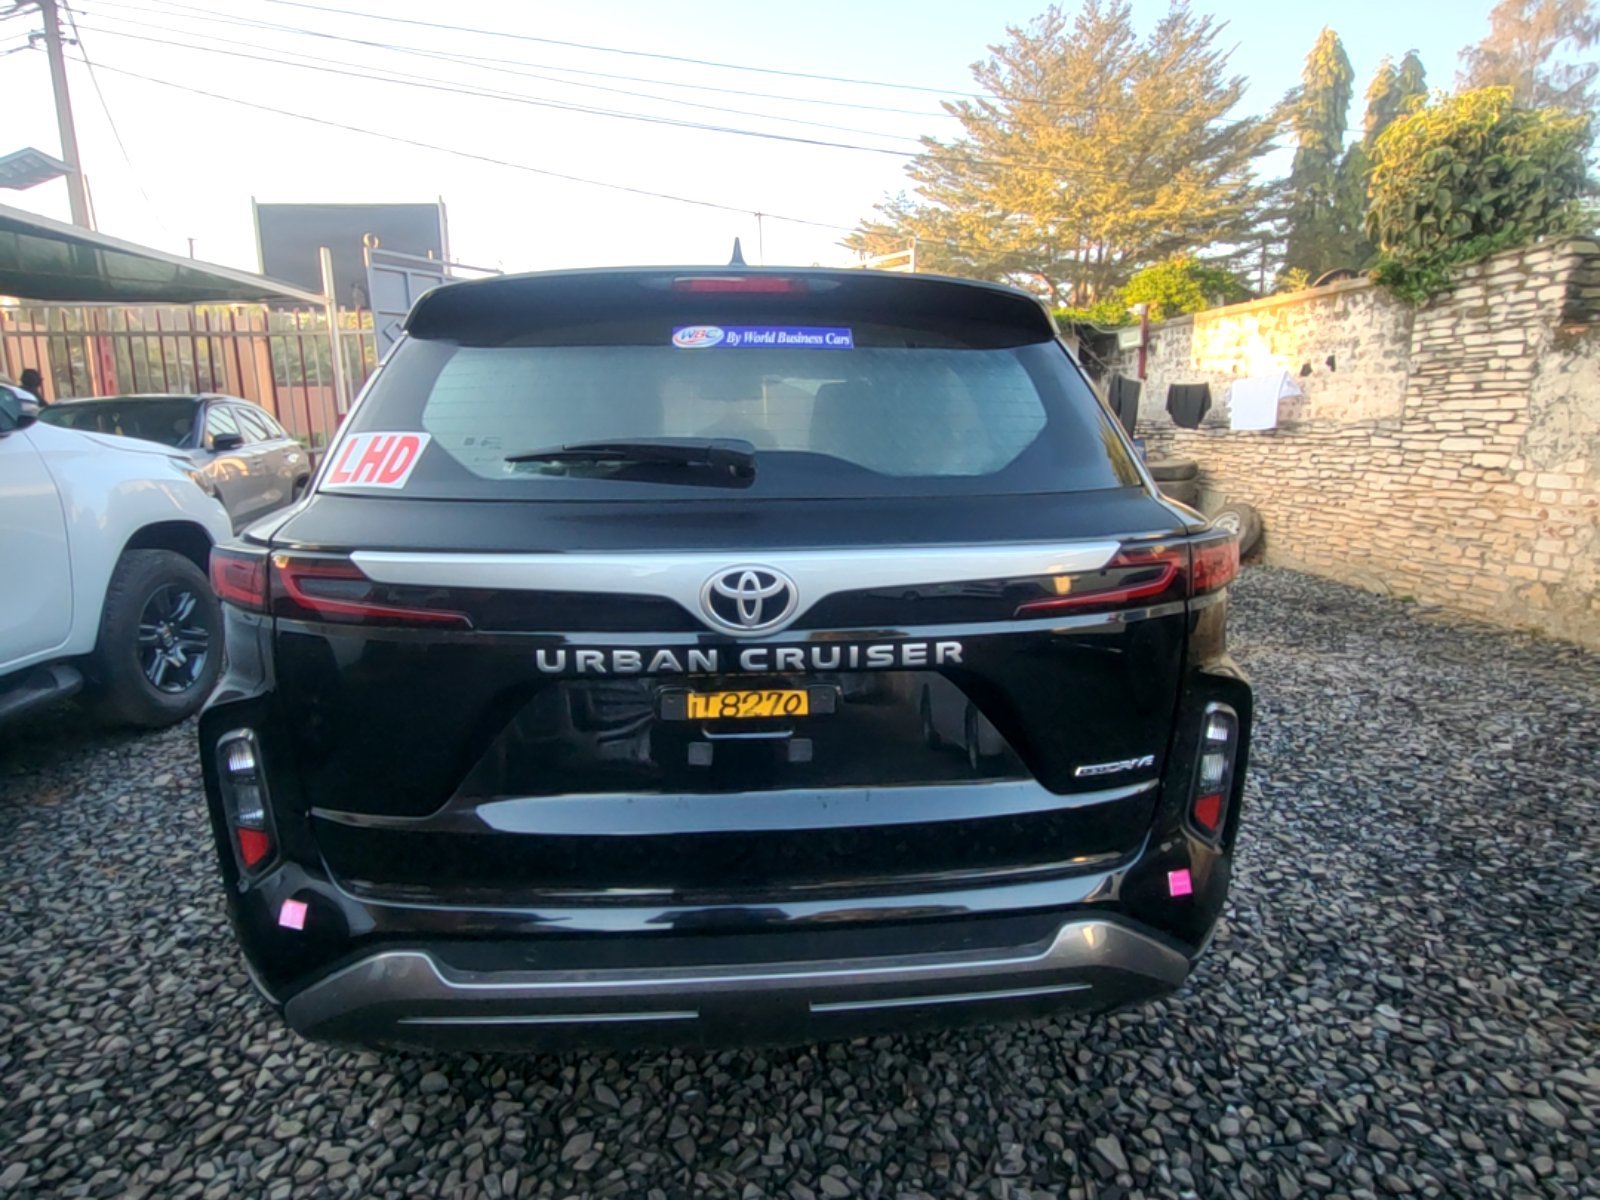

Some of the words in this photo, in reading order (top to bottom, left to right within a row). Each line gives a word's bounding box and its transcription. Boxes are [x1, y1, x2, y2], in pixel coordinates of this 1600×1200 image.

[726, 331, 742, 346] By
[744, 331, 776, 344] World
[777, 331, 823, 345] Business
[825, 332, 850, 345] Cars
[328, 435, 420, 484] LHD
[536, 649, 718, 673] URBAN
[740, 641, 964, 671] CRUISER
